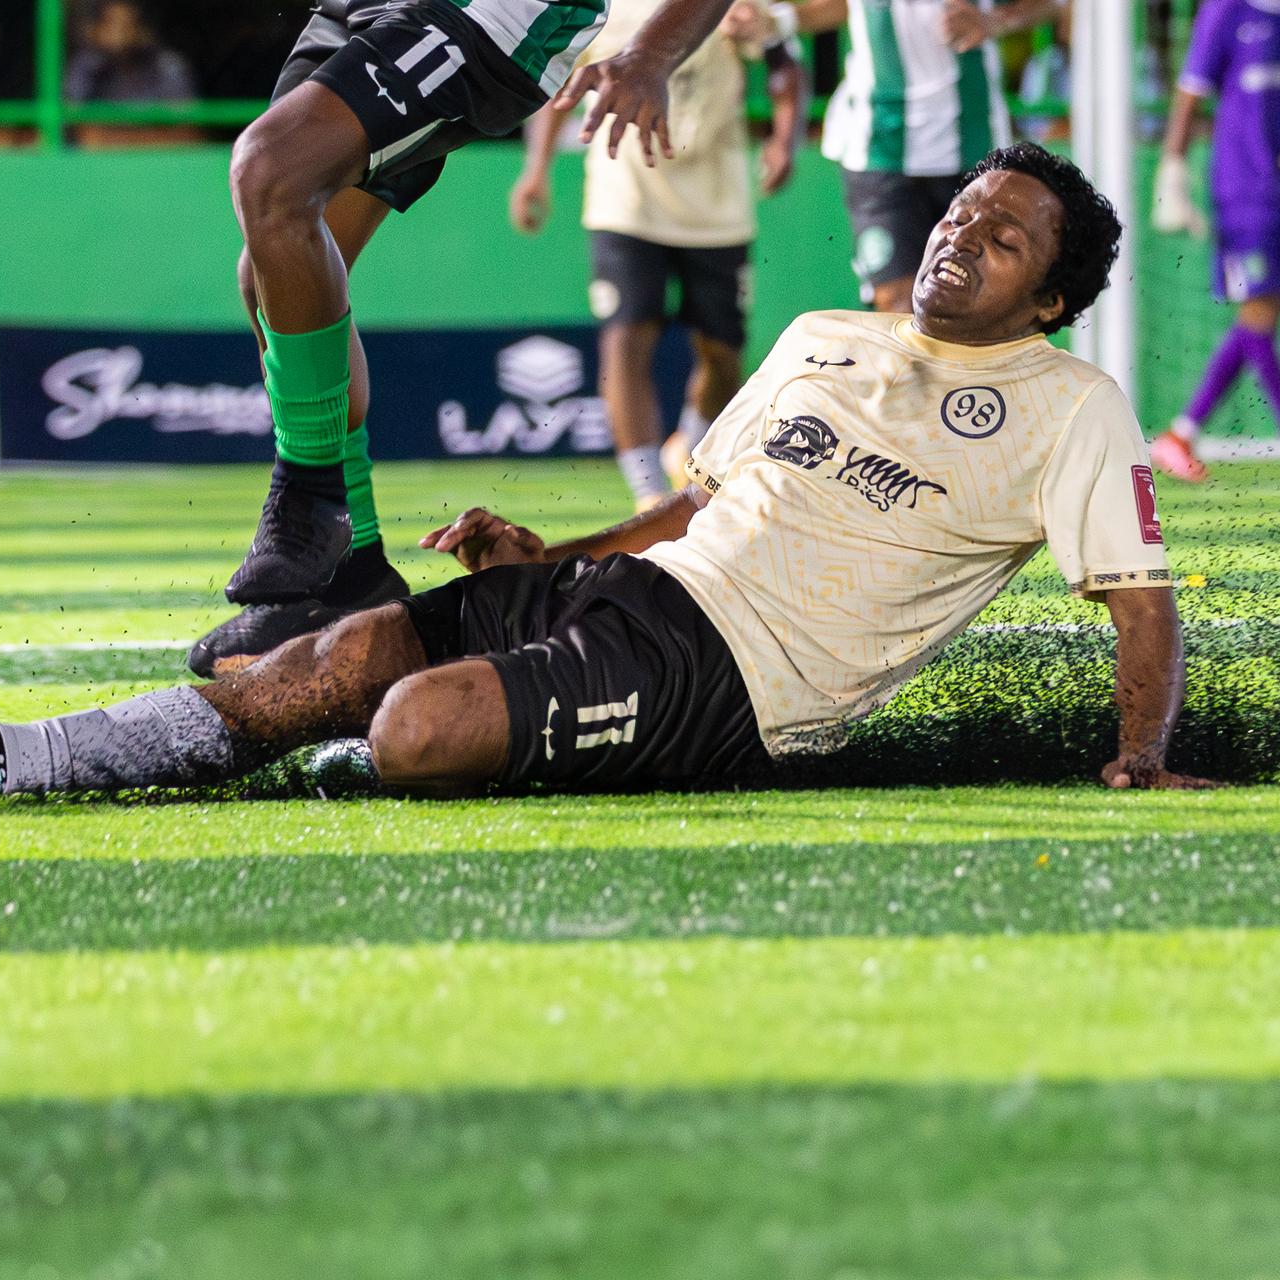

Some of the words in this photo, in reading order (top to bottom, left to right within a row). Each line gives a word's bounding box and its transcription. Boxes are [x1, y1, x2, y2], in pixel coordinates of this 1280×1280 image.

[394, 23, 466, 98] 11
[953, 393, 996, 428] 98
[576, 691, 639, 750] 11
